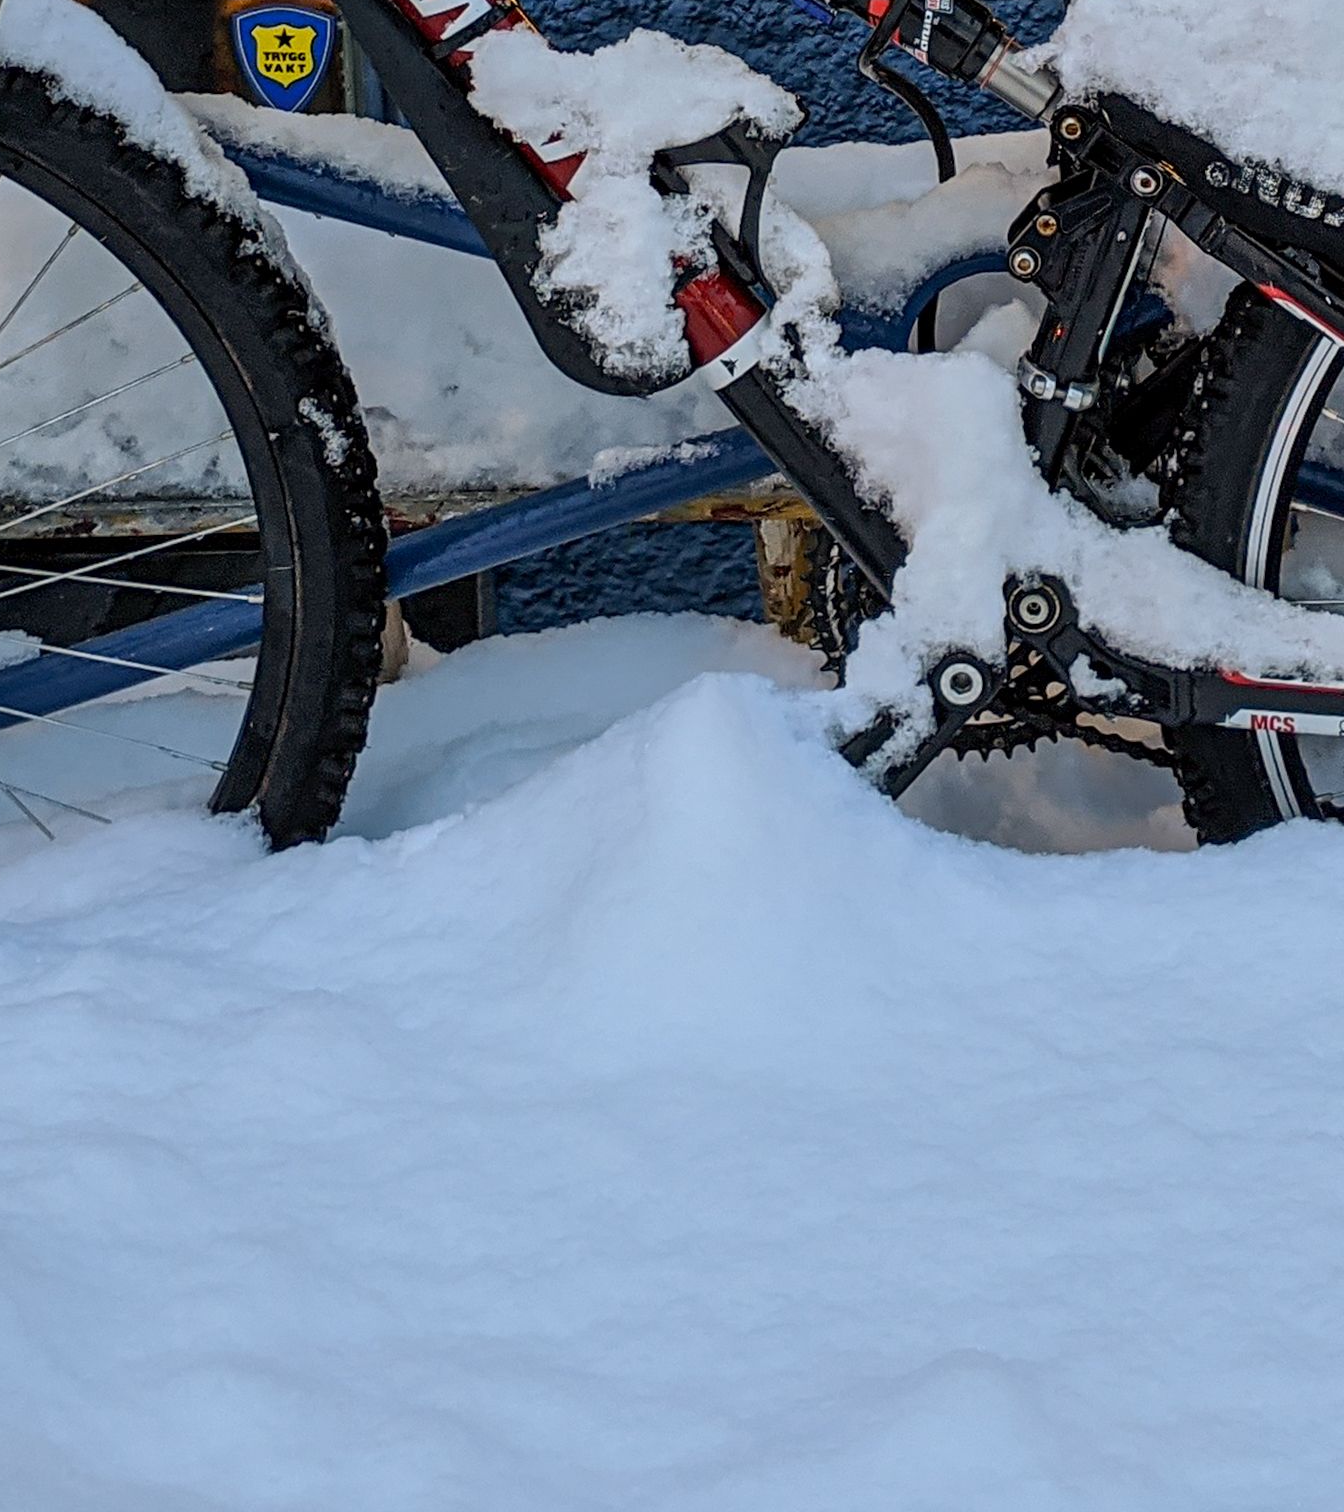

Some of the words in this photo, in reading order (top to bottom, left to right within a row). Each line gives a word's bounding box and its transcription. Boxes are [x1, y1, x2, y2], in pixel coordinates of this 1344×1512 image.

[263, 51, 306, 62] TRYGG
[263, 63, 306, 74] VAKT
[1250, 714, 1295, 733] MCS
